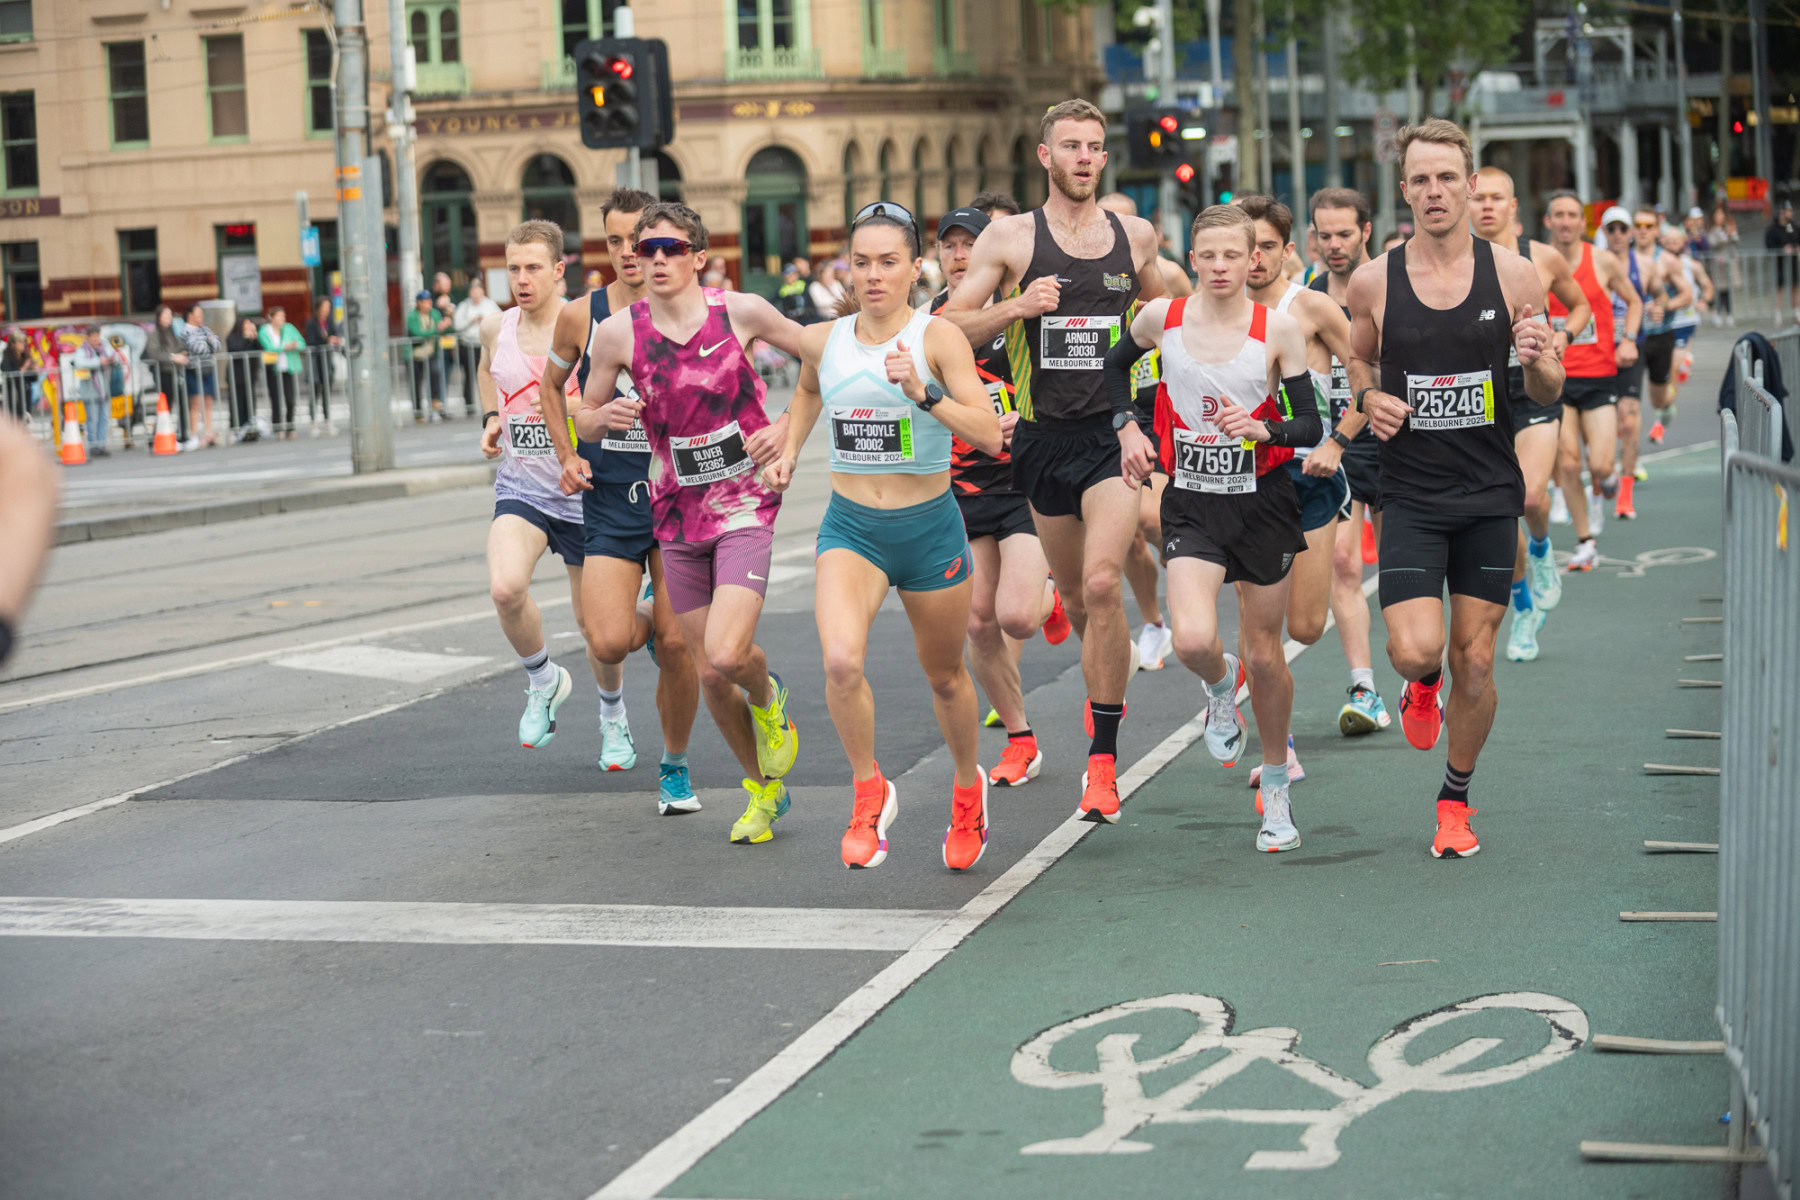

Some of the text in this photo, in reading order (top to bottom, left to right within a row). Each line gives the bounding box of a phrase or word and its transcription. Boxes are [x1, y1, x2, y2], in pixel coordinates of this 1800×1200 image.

[426, 113, 520, 133] YOUNG
[1064, 332, 1099, 344] ARNOLD
[1067, 345, 1096, 357] 20030
[1416, 387, 1485, 417] 25246
[1417, 415, 1486, 428] MELBOURNE 2025
[842, 423, 896, 437] BATT-DOYLE
[608, 441, 649, 450] MELBOURNE
[854, 438, 884, 451] 20002
[902, 434, 913, 457] ELITE
[517, 448, 552, 456] MELBOURNE
[692, 446, 723, 462] OLIVER
[840, 452, 906, 462] MELBOURNE 2025
[697, 457, 727, 473] 23362
[1182, 444, 1245, 475] 27597
[684, 470, 727, 484] MELBOURNE
[1182, 472, 1248, 484] MELBOURNE 2025
